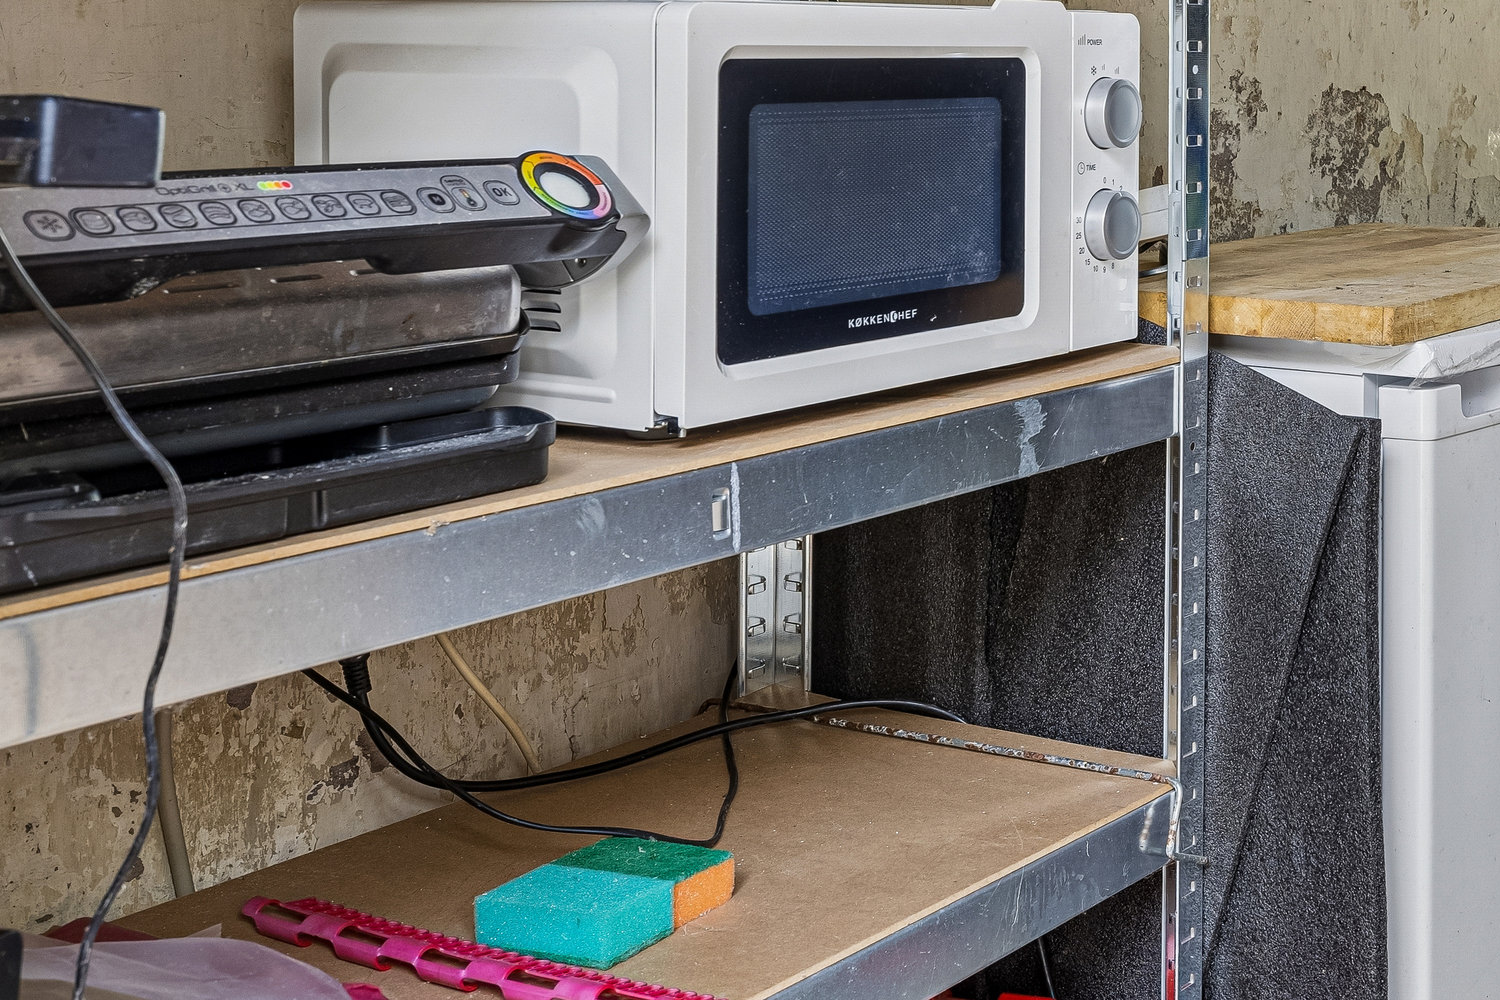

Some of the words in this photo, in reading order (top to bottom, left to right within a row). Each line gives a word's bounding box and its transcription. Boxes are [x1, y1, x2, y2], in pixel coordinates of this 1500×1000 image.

[1087, 38, 1102, 46] POWER
[492, 187, 513, 197] OK
[1076, 216, 1082, 224] 30
[848, 308, 918, 328] KØKKENCHEF
